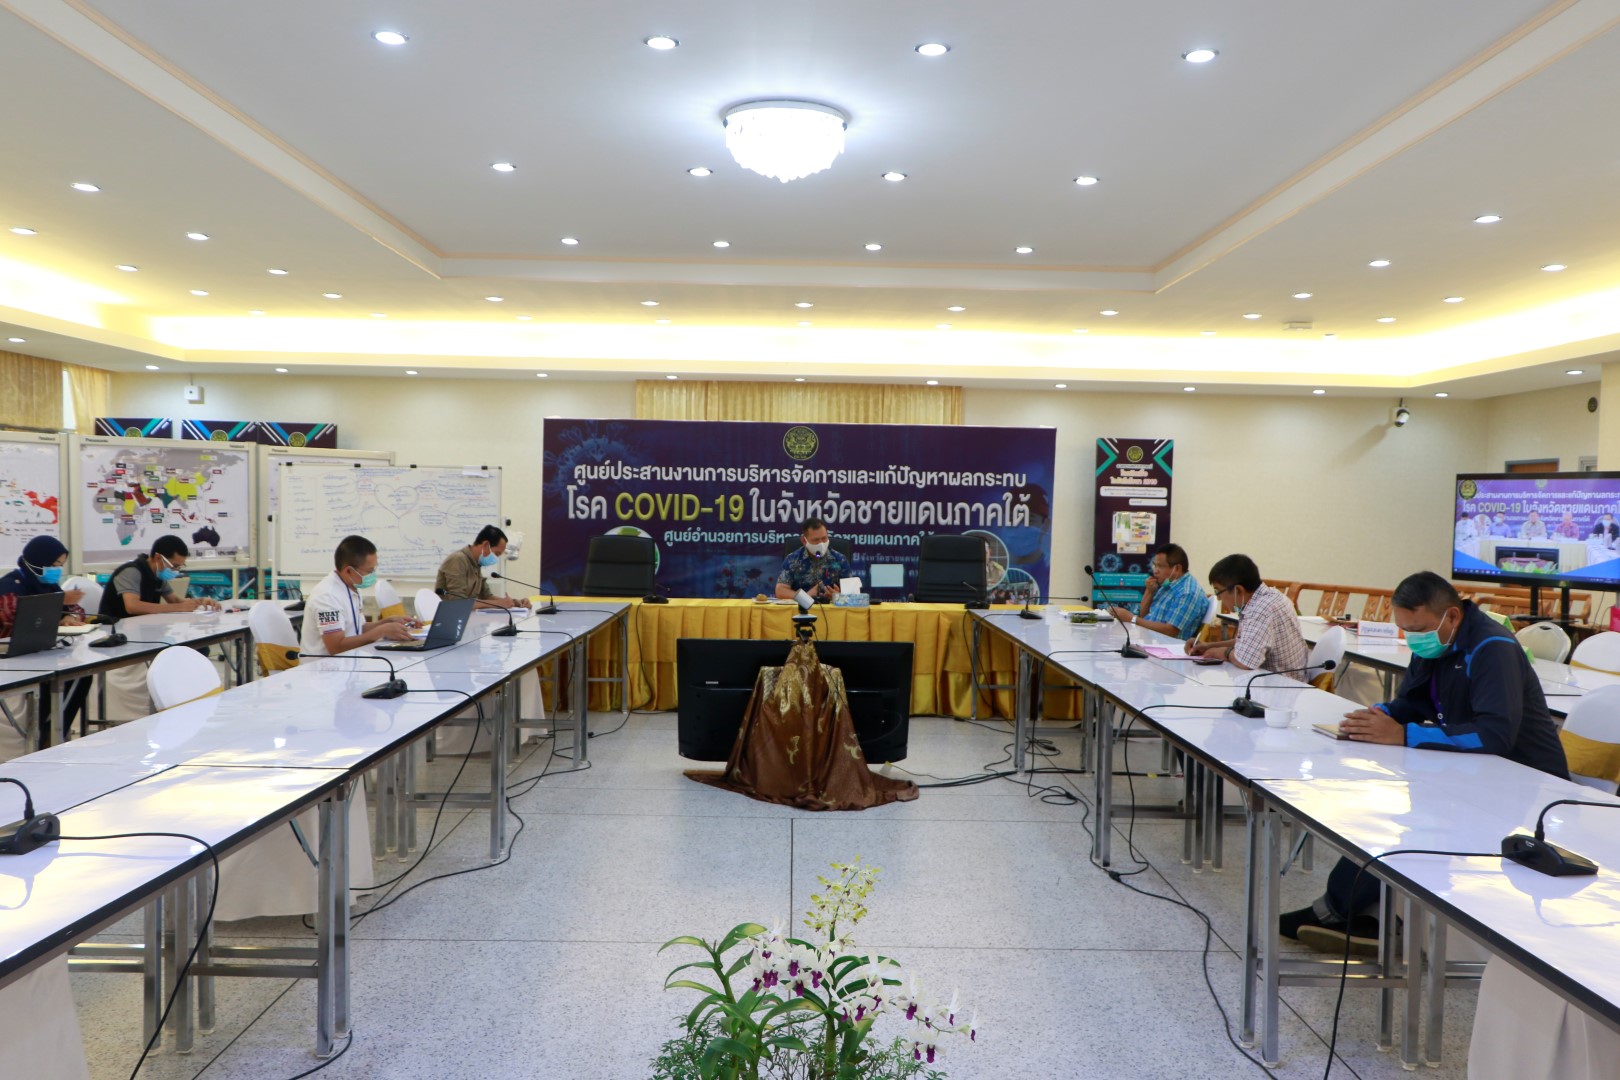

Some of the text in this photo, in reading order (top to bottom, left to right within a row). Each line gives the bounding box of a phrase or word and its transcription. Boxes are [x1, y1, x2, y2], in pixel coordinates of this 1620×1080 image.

[574, 460, 1027, 488] ศูนย์ประสานงานการบริหารจัดการและแก้ปัญหาผลกระทบ
[567, 484, 1031, 527] โรค COVID-19 ในจังหวัดชายแดนภาคใต้
[1478, 502, 1521, 513] COVID-19
